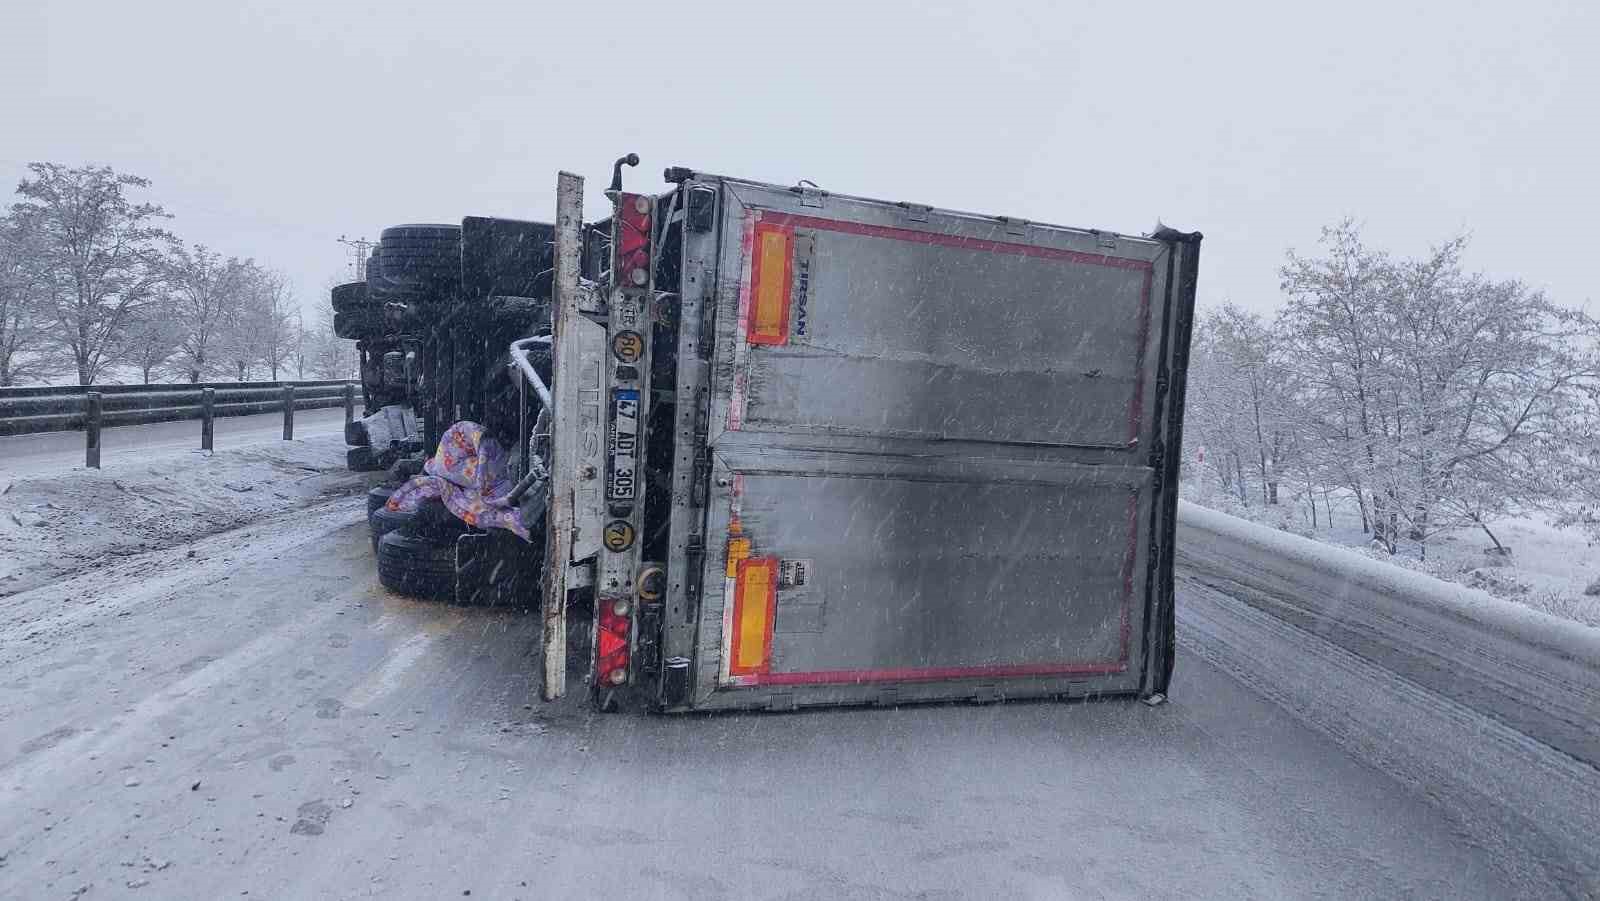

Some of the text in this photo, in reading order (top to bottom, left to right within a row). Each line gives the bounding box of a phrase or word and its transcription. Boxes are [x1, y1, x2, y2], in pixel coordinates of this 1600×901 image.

[797, 259, 809, 336] TIRSAN
[614, 400, 637, 497] 47 ADT 305
